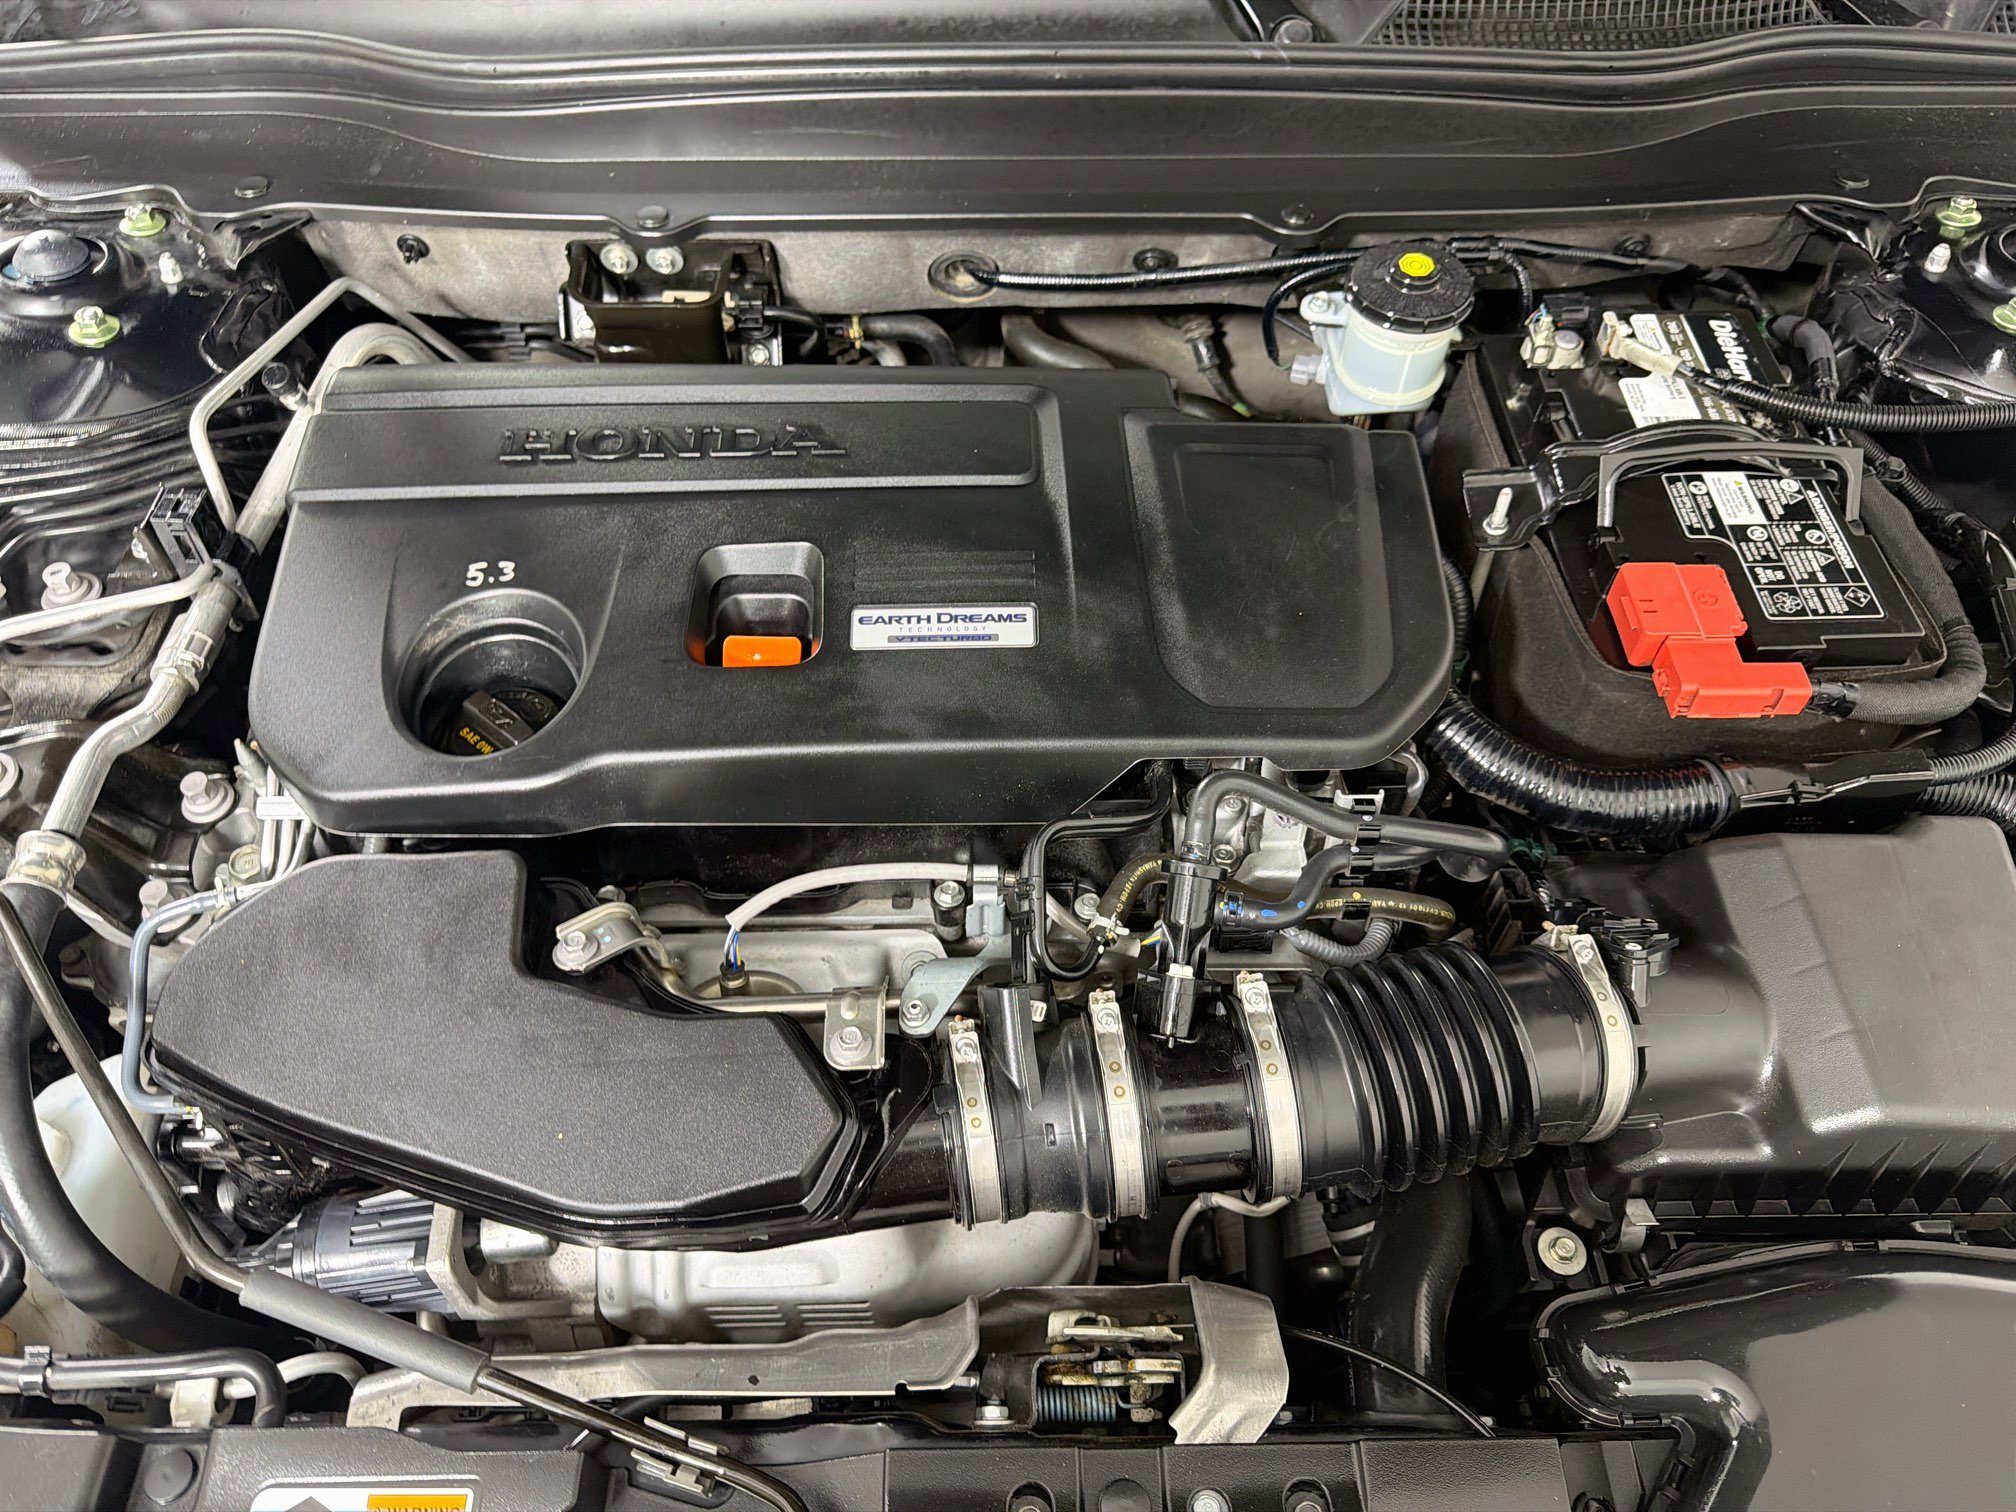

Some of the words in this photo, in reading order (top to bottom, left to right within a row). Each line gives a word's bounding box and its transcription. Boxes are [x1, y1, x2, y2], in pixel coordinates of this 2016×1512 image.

[1708, 320, 1752, 381] DieHar
[499, 424, 848, 464] HONDA
[1809, 498, 1854, 568] DANGER/POISON
[465, 561, 516, 588] 5.3
[858, 614, 931, 626] EARTH
[936, 612, 1028, 624] DREAMS
[460, 727, 480, 746] SAE
